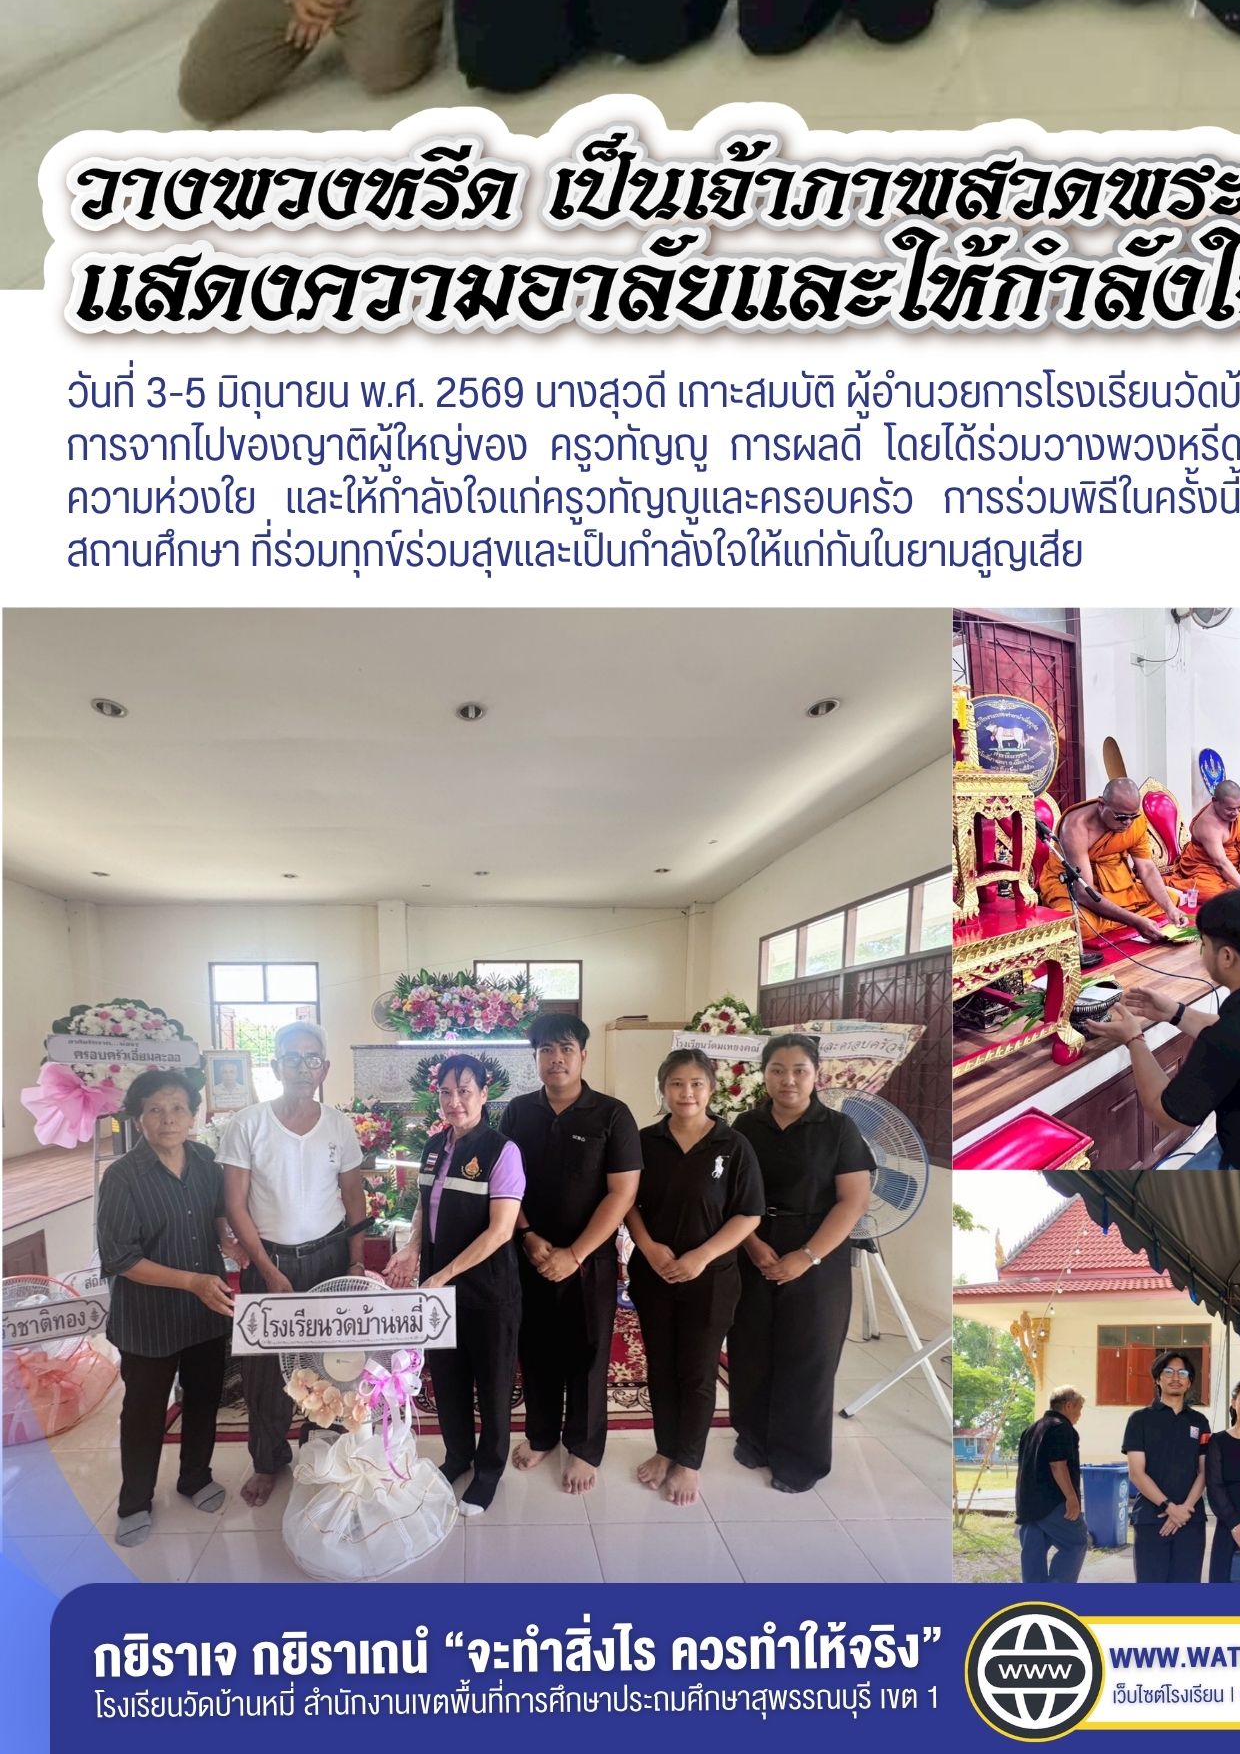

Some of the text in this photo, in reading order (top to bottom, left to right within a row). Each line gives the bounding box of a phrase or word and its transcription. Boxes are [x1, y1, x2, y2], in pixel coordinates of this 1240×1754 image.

[261, 1298, 424, 1338] โรงเรียนวัดบ้านหมี่
